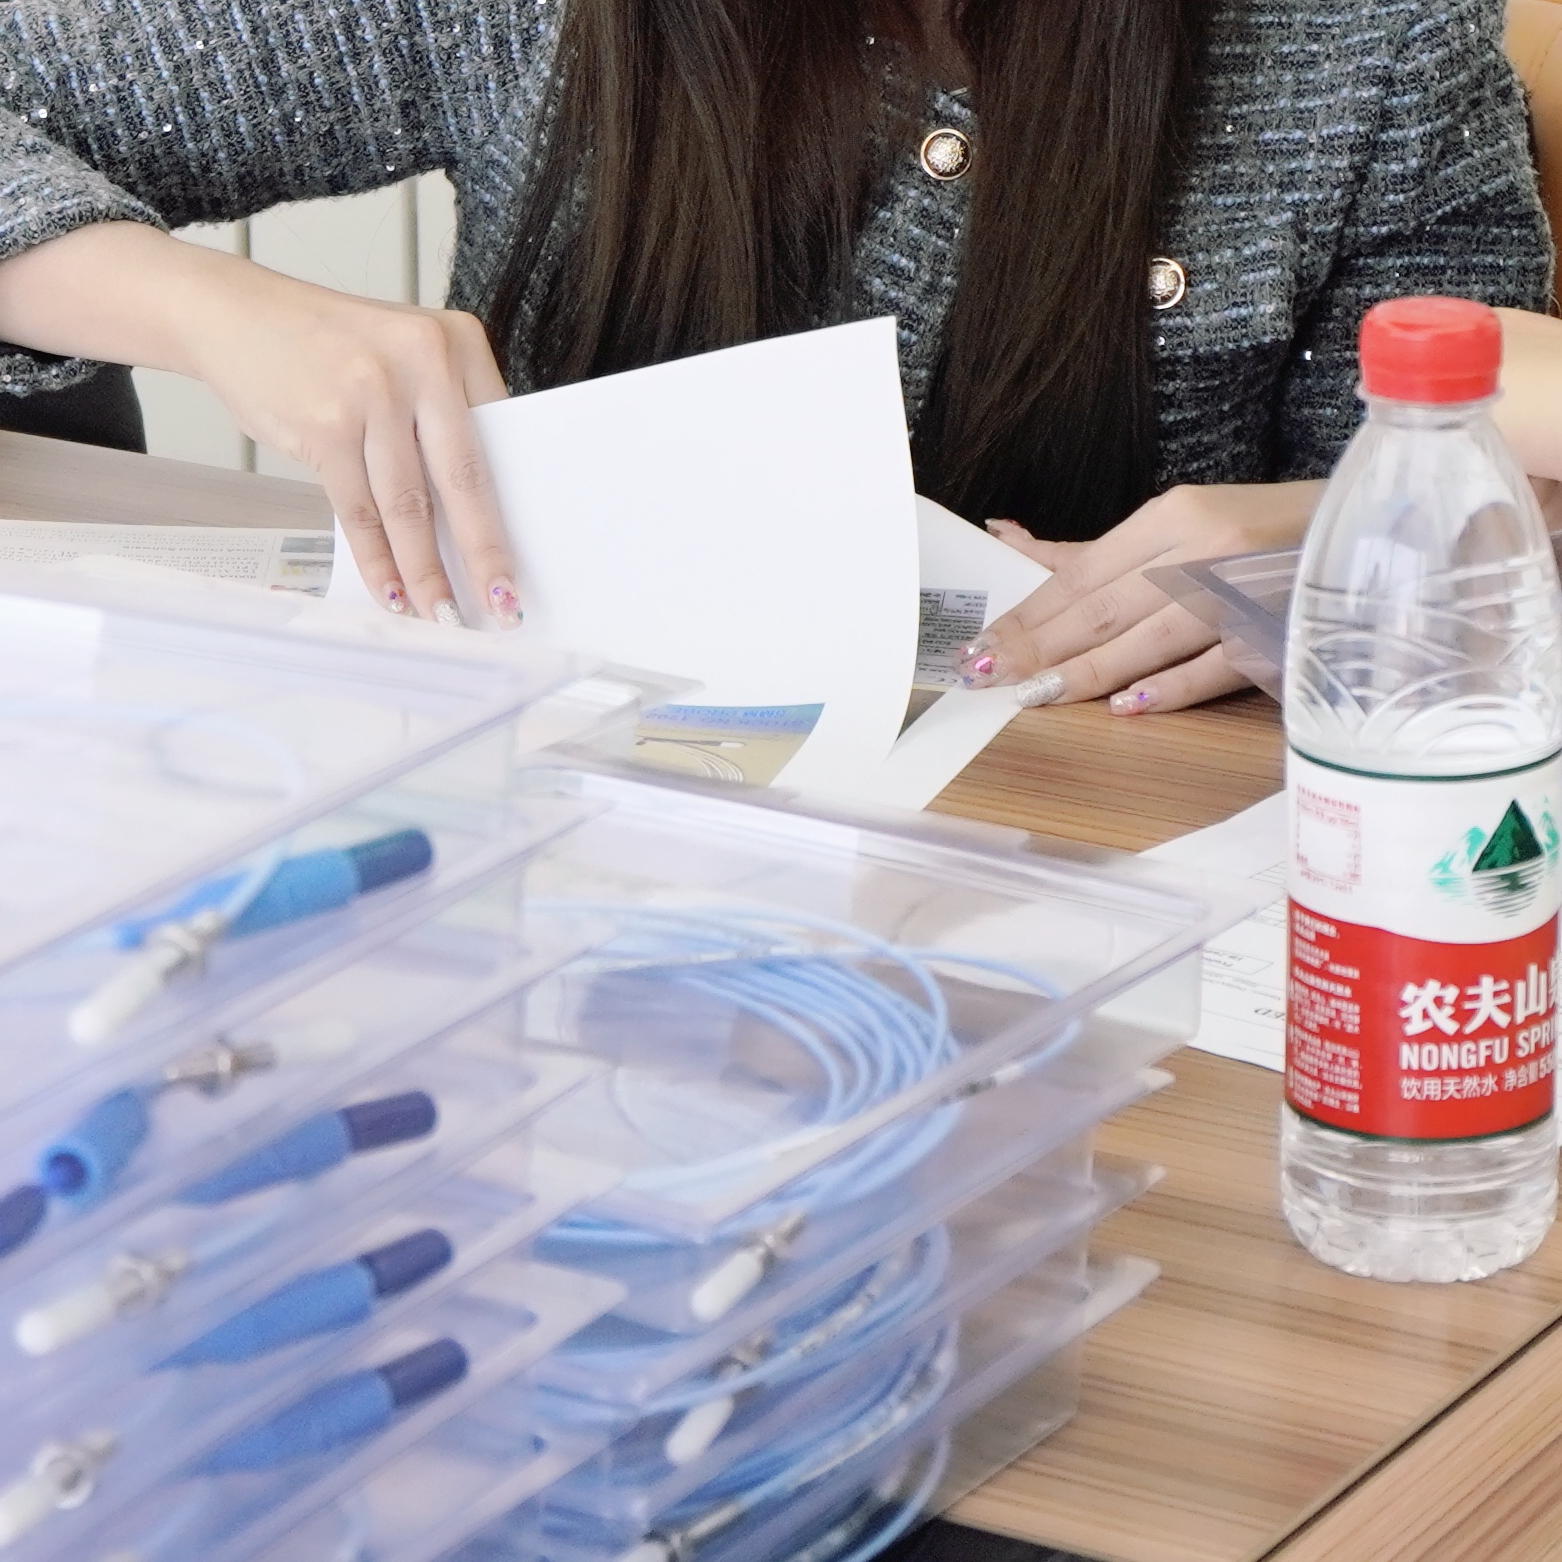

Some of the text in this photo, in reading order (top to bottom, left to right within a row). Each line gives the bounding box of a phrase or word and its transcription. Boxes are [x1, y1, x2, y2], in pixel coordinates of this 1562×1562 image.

[1399, 1036, 1510, 1071] NONGFU
[1515, 1018, 1557, 1058] SPRI
[1400, 1072, 1499, 1101] 饮用天然水
